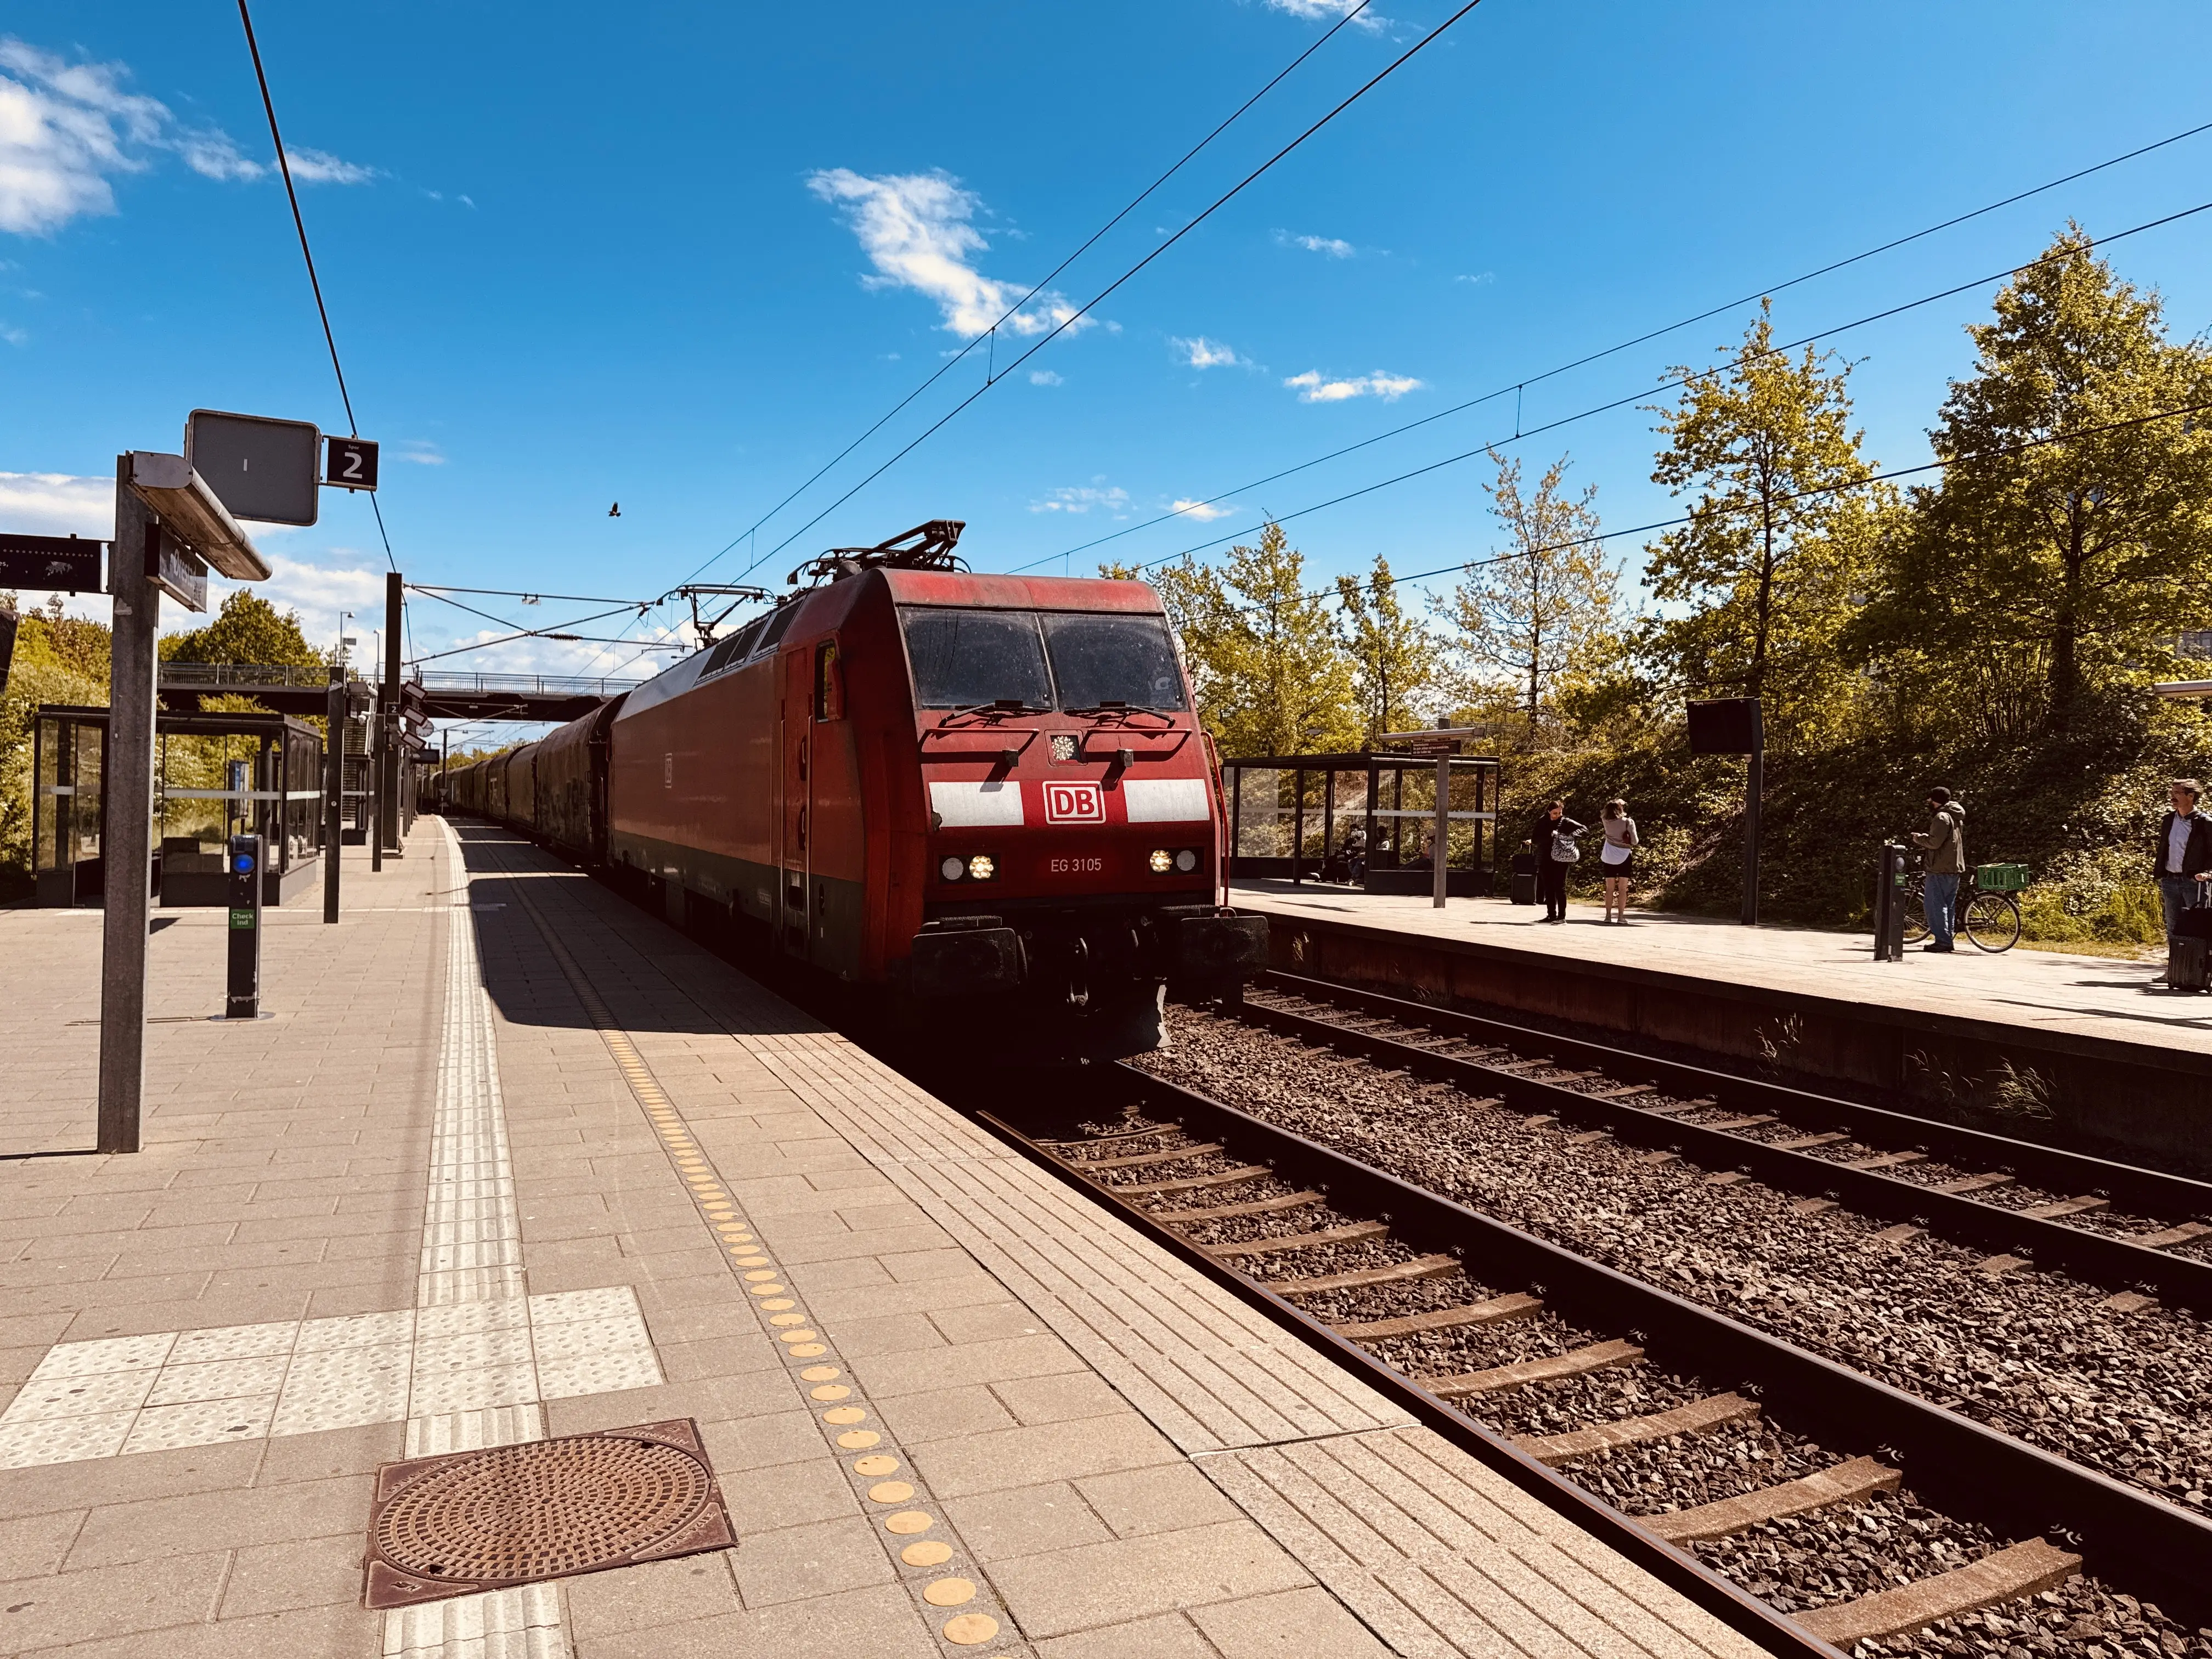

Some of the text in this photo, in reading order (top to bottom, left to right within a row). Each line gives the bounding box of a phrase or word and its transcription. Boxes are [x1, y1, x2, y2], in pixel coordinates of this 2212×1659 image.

[343, 452, 362, 479] 2
[1053, 789, 1094, 815] DB
[1051, 858, 1102, 872] EG 3105
